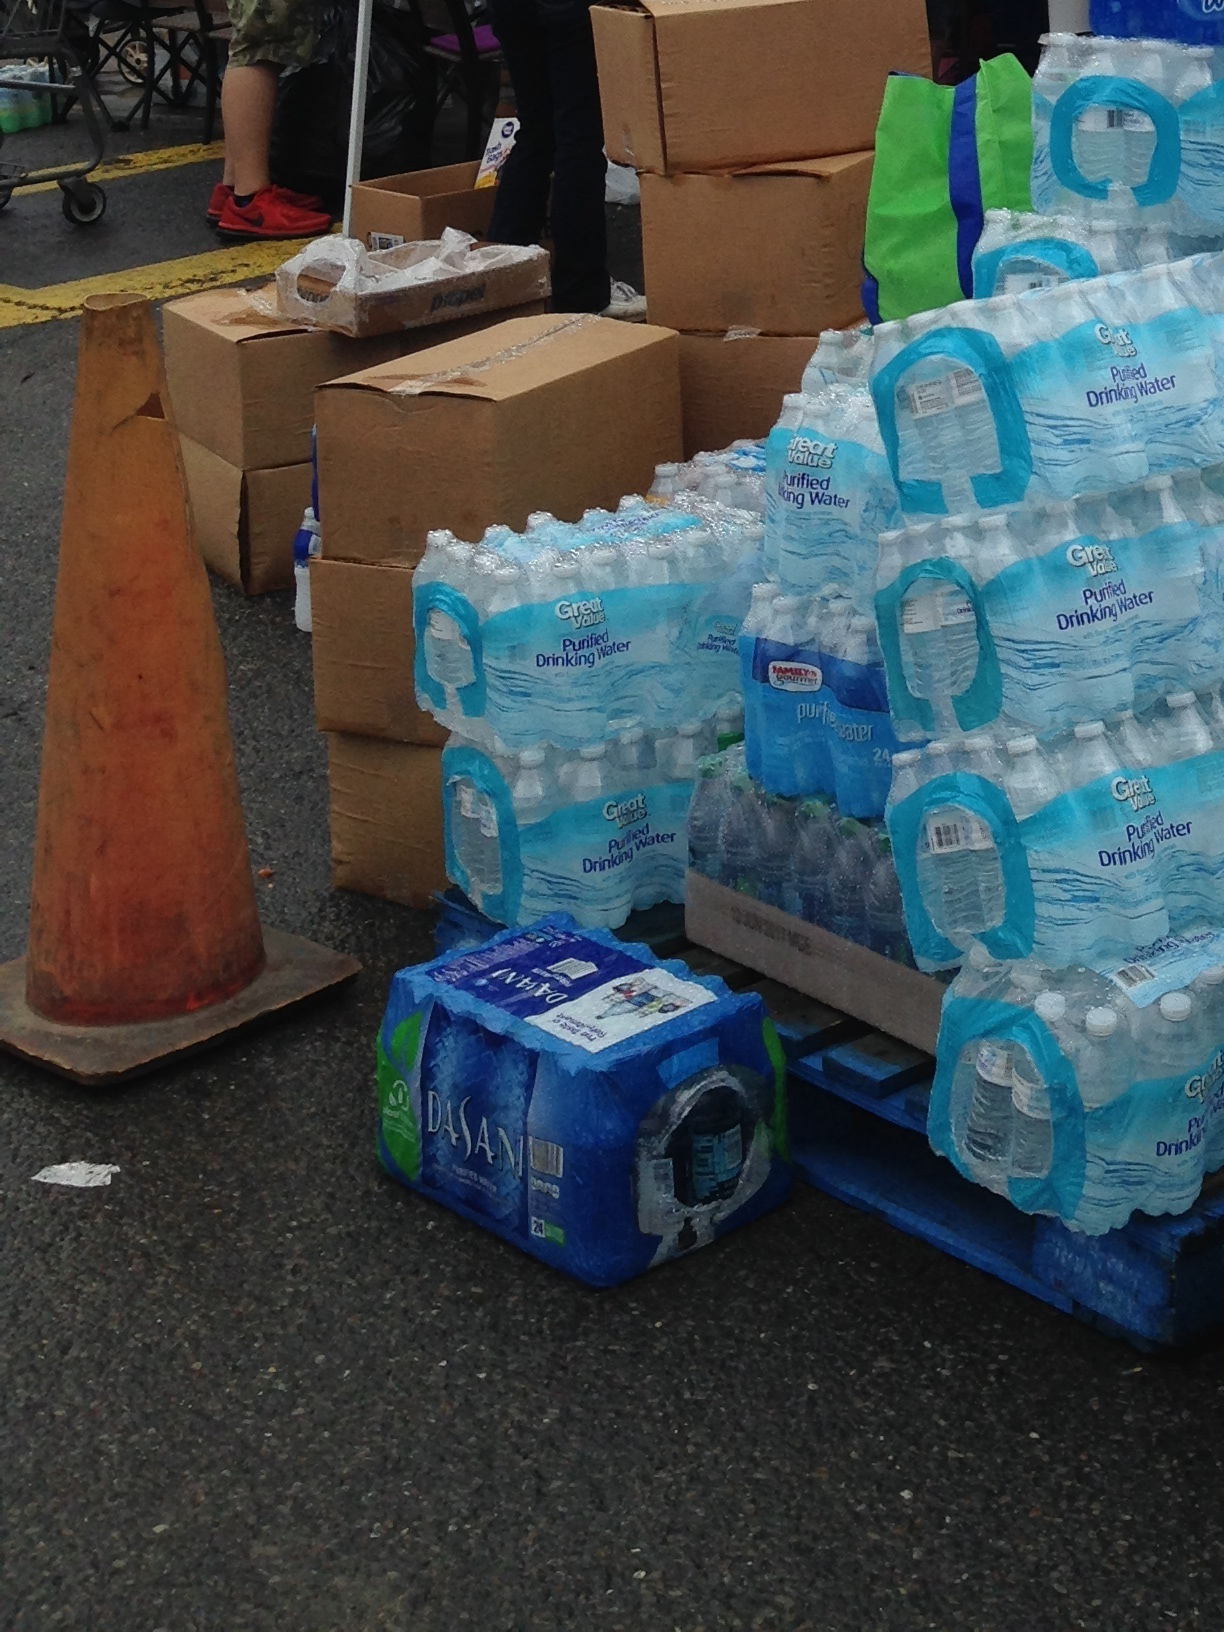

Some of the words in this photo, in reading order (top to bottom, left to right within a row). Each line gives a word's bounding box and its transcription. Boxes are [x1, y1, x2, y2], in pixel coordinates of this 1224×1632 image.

[1086, 383, 1138, 408] Drinking
[1138, 375, 1177, 397] Water
[788, 449, 833, 469] Value
[809, 491, 851, 509] Water
[554, 596, 605, 622] Great
[571, 611, 606, 629] Value
[1056, 602, 1118, 632] Drinking
[1118, 589, 1154, 614] Water
[535, 650, 595, 669] Drinking
[597, 639, 632, 661] Water
[562, 629, 609, 652] Purified
[872, 747, 890, 762] 24
[602, 792, 647, 821] Great
[582, 848, 634, 874] Drinking
[634, 832, 677, 852] Water
[1098, 835, 1155, 868] Drinking
[1154, 820, 1193, 847] Water
[427, 1089, 524, 1181] DASANI
